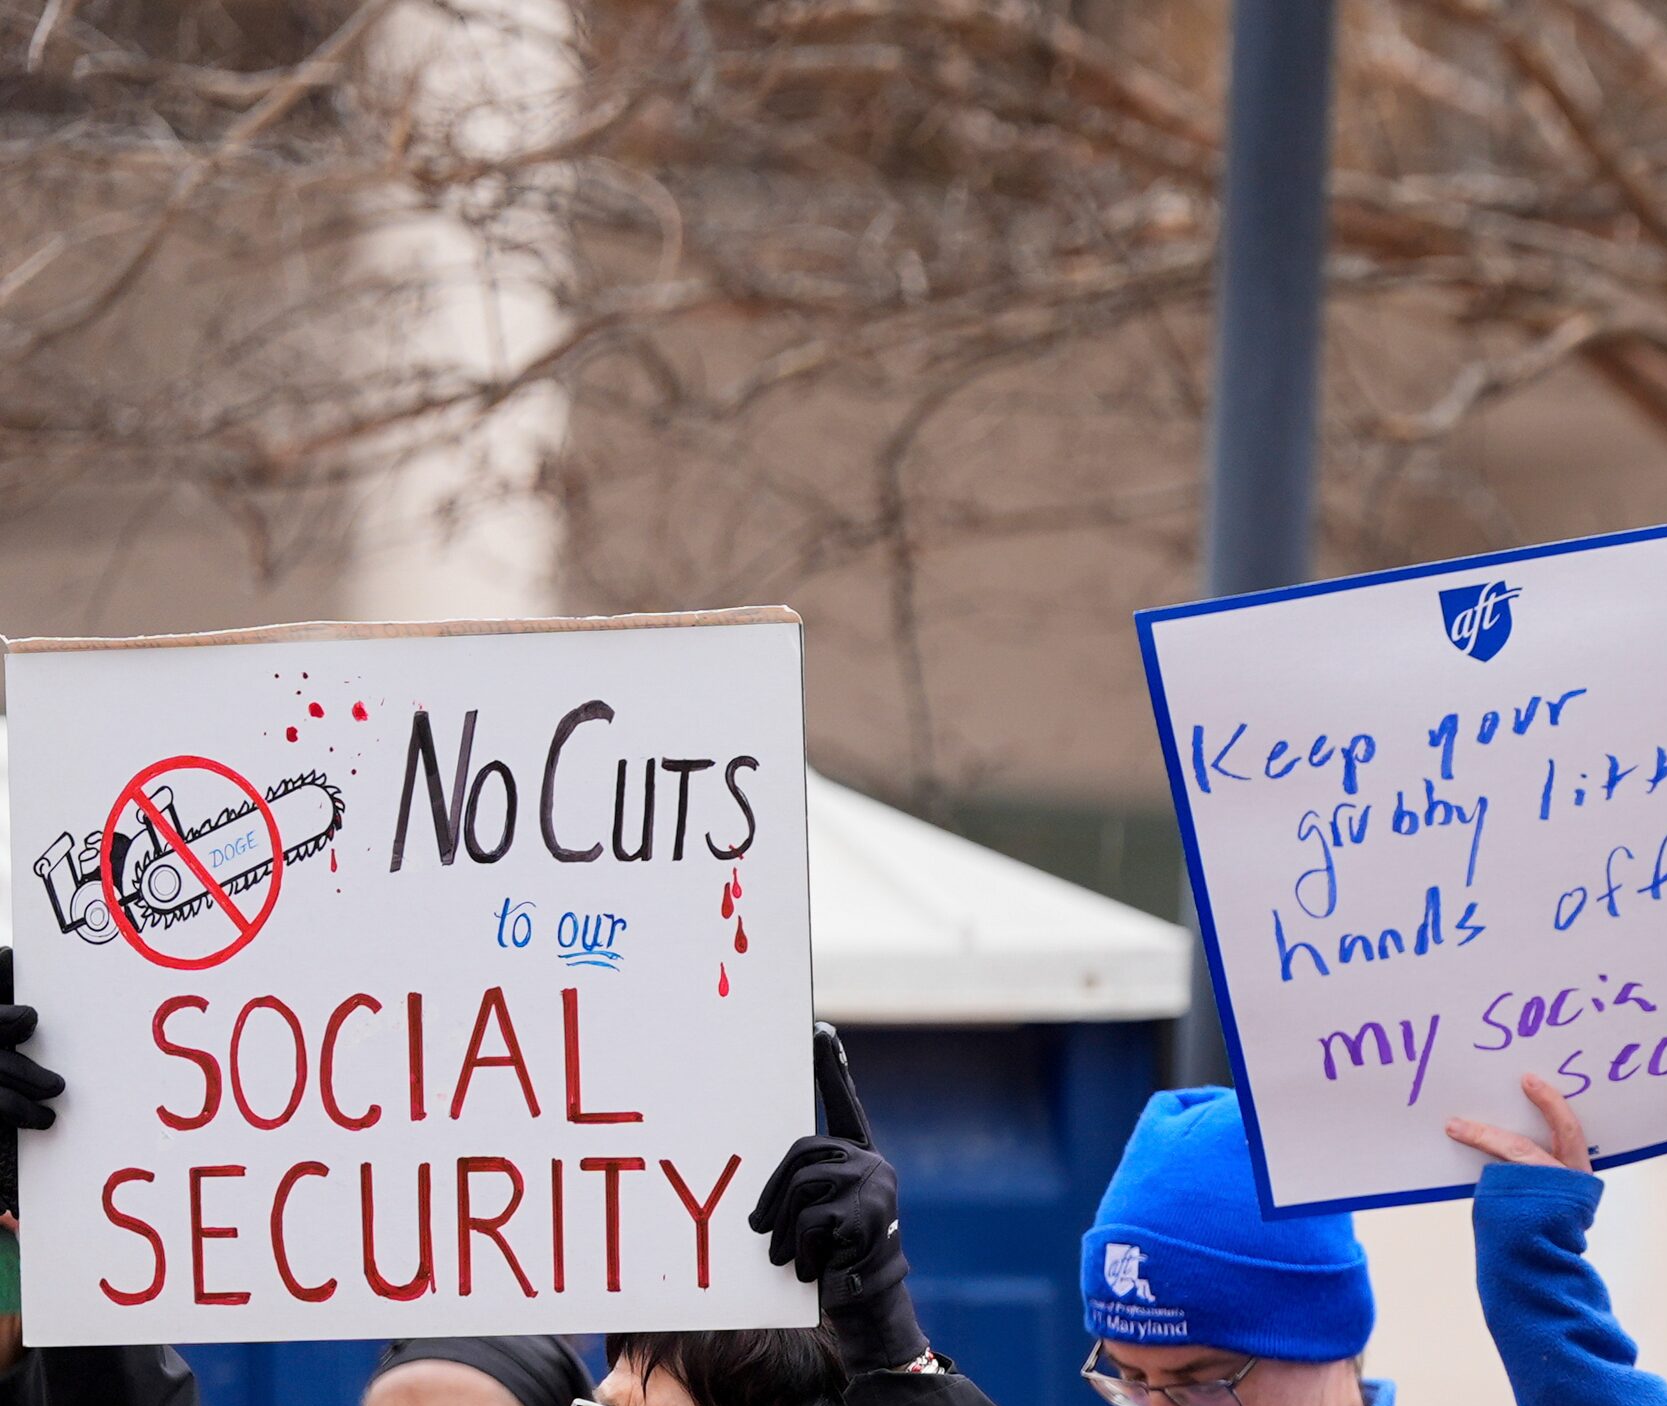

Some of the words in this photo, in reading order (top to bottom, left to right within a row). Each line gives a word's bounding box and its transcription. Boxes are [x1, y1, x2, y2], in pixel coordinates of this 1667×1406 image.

[1451, 580, 1523, 655] aft
[1191, 723, 1376, 795] Keep
[1428, 688, 1587, 781] your
[209, 829, 258, 868] DOGE
[1297, 779, 1487, 918] grubby
[494, 898, 532, 948] to
[558, 913, 628, 950] our
[1272, 886, 1486, 982] hands
[152, 986, 644, 1132] SOCIAL
[1319, 1014, 1440, 1106] my
[99, 1154, 742, 1307] SECURITY
